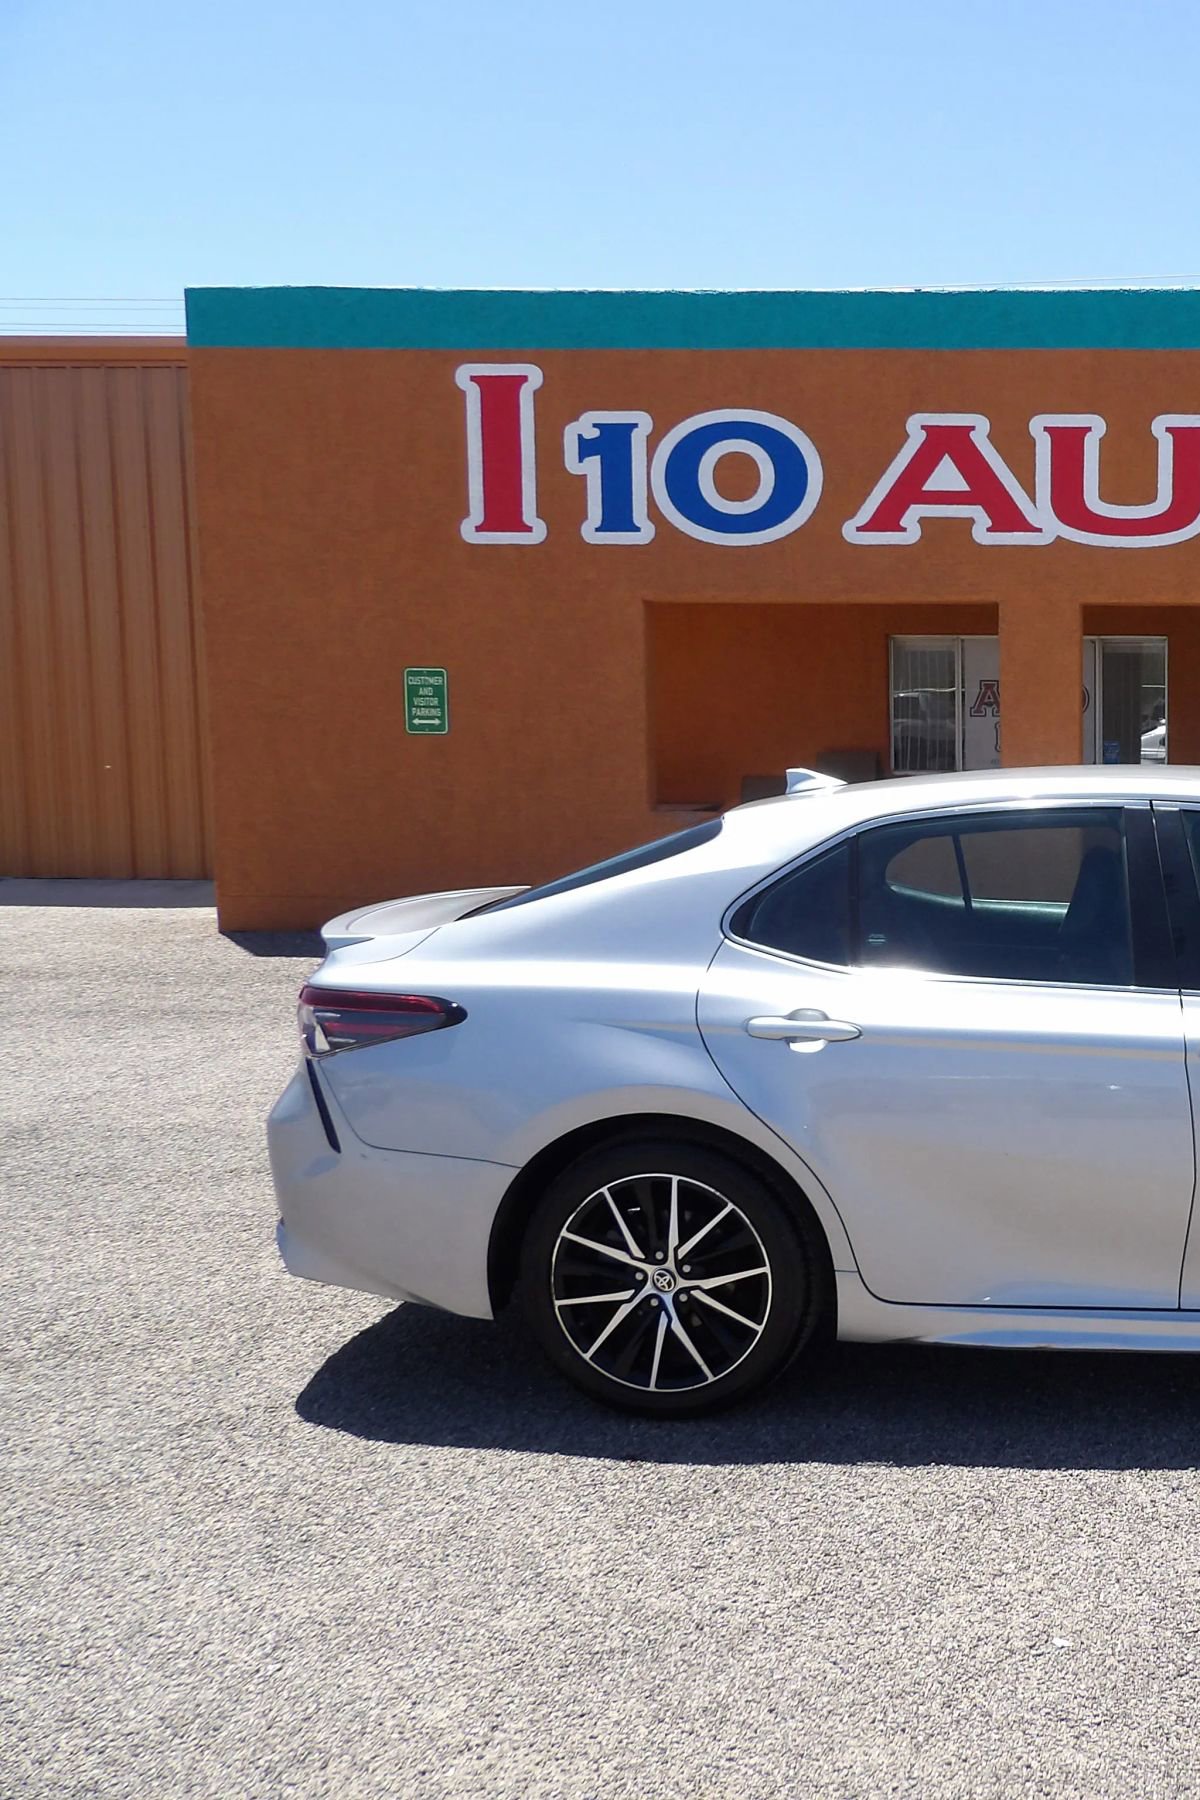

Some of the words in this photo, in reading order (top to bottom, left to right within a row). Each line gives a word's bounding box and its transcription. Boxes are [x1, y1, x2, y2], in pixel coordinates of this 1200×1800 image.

[408, 676, 443, 686] CUSTOMER
[419, 687, 434, 696] AND
[413, 697, 439, 706] VISITOR
[411, 707, 442, 717] PARKING
